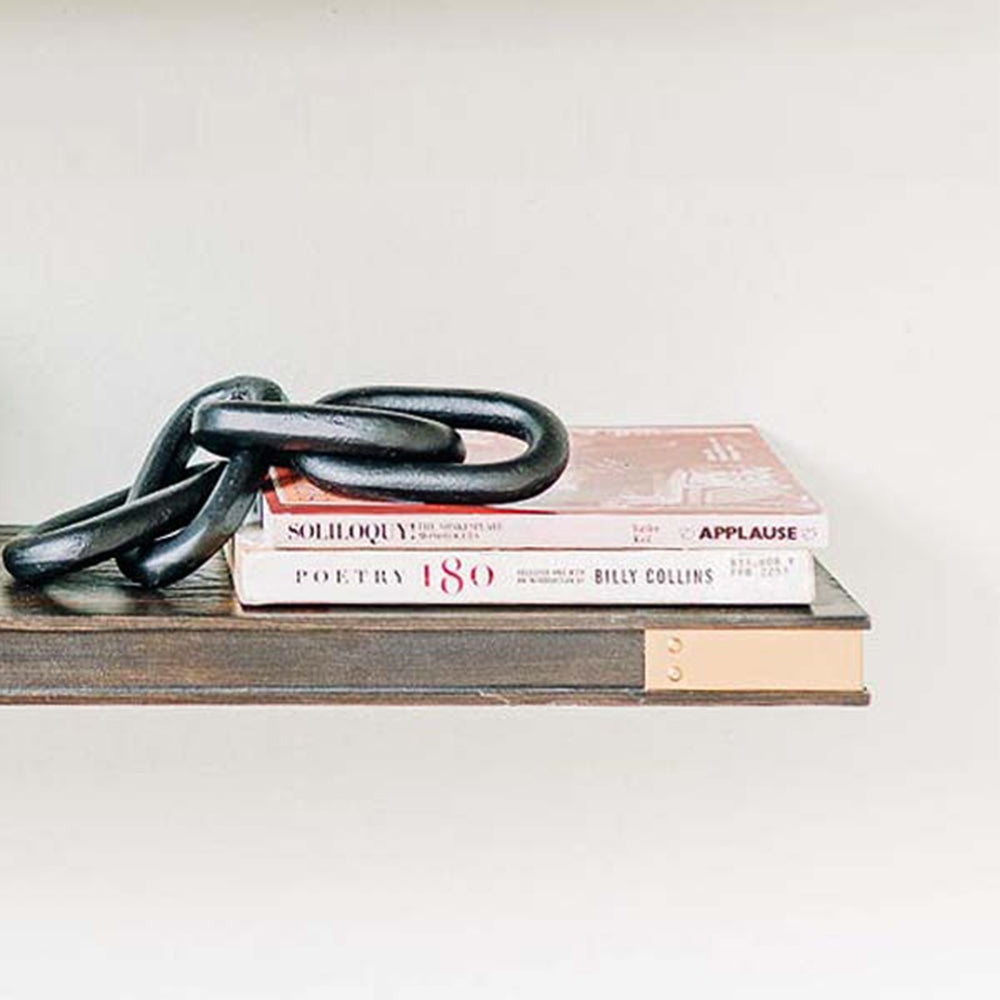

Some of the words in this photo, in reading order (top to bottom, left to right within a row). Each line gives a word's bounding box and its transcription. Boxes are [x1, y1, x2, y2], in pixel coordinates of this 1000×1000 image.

[287, 521, 416, 544] SOLILOQUY!
[698, 526, 798, 541] APPLAUSE
[295, 569, 403, 585] POETRY
[423, 557, 495, 595] 180
[594, 568, 637, 585] BILLY
[645, 568, 715, 585] COLLINS
